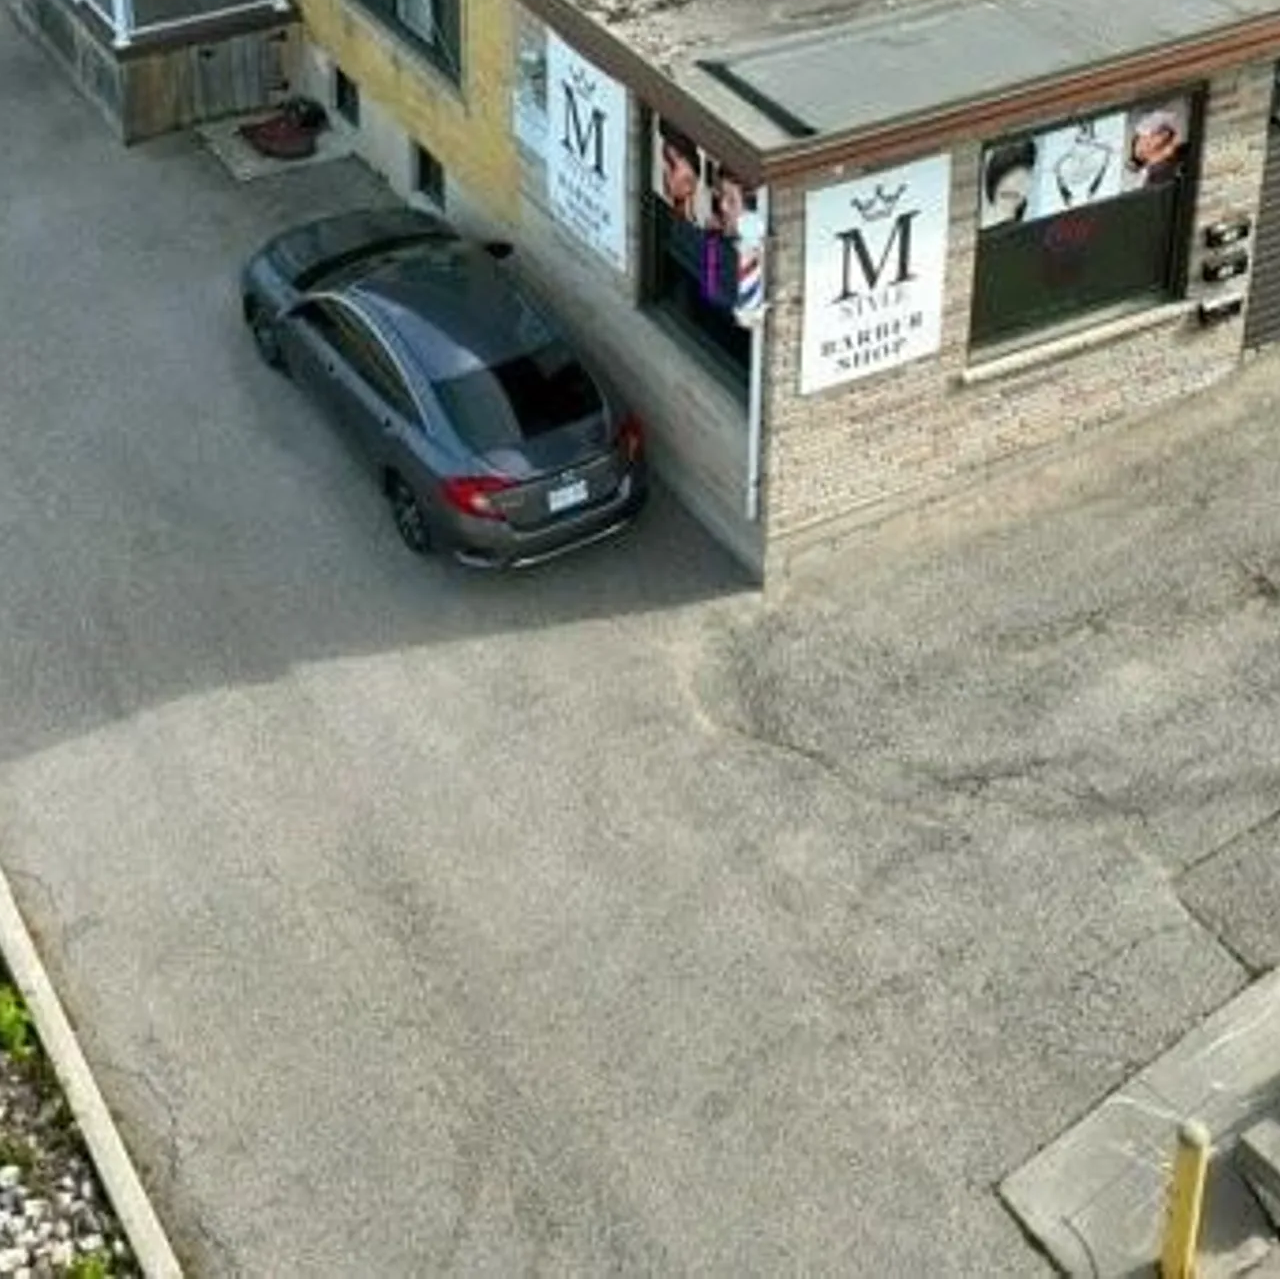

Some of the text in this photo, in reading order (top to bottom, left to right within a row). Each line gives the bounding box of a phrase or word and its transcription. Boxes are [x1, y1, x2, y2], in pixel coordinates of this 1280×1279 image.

[562, 79, 607, 180] M
[831, 209, 921, 304] M
[821, 311, 923, 357] BARBER
[836, 337, 907, 370] SHOP
